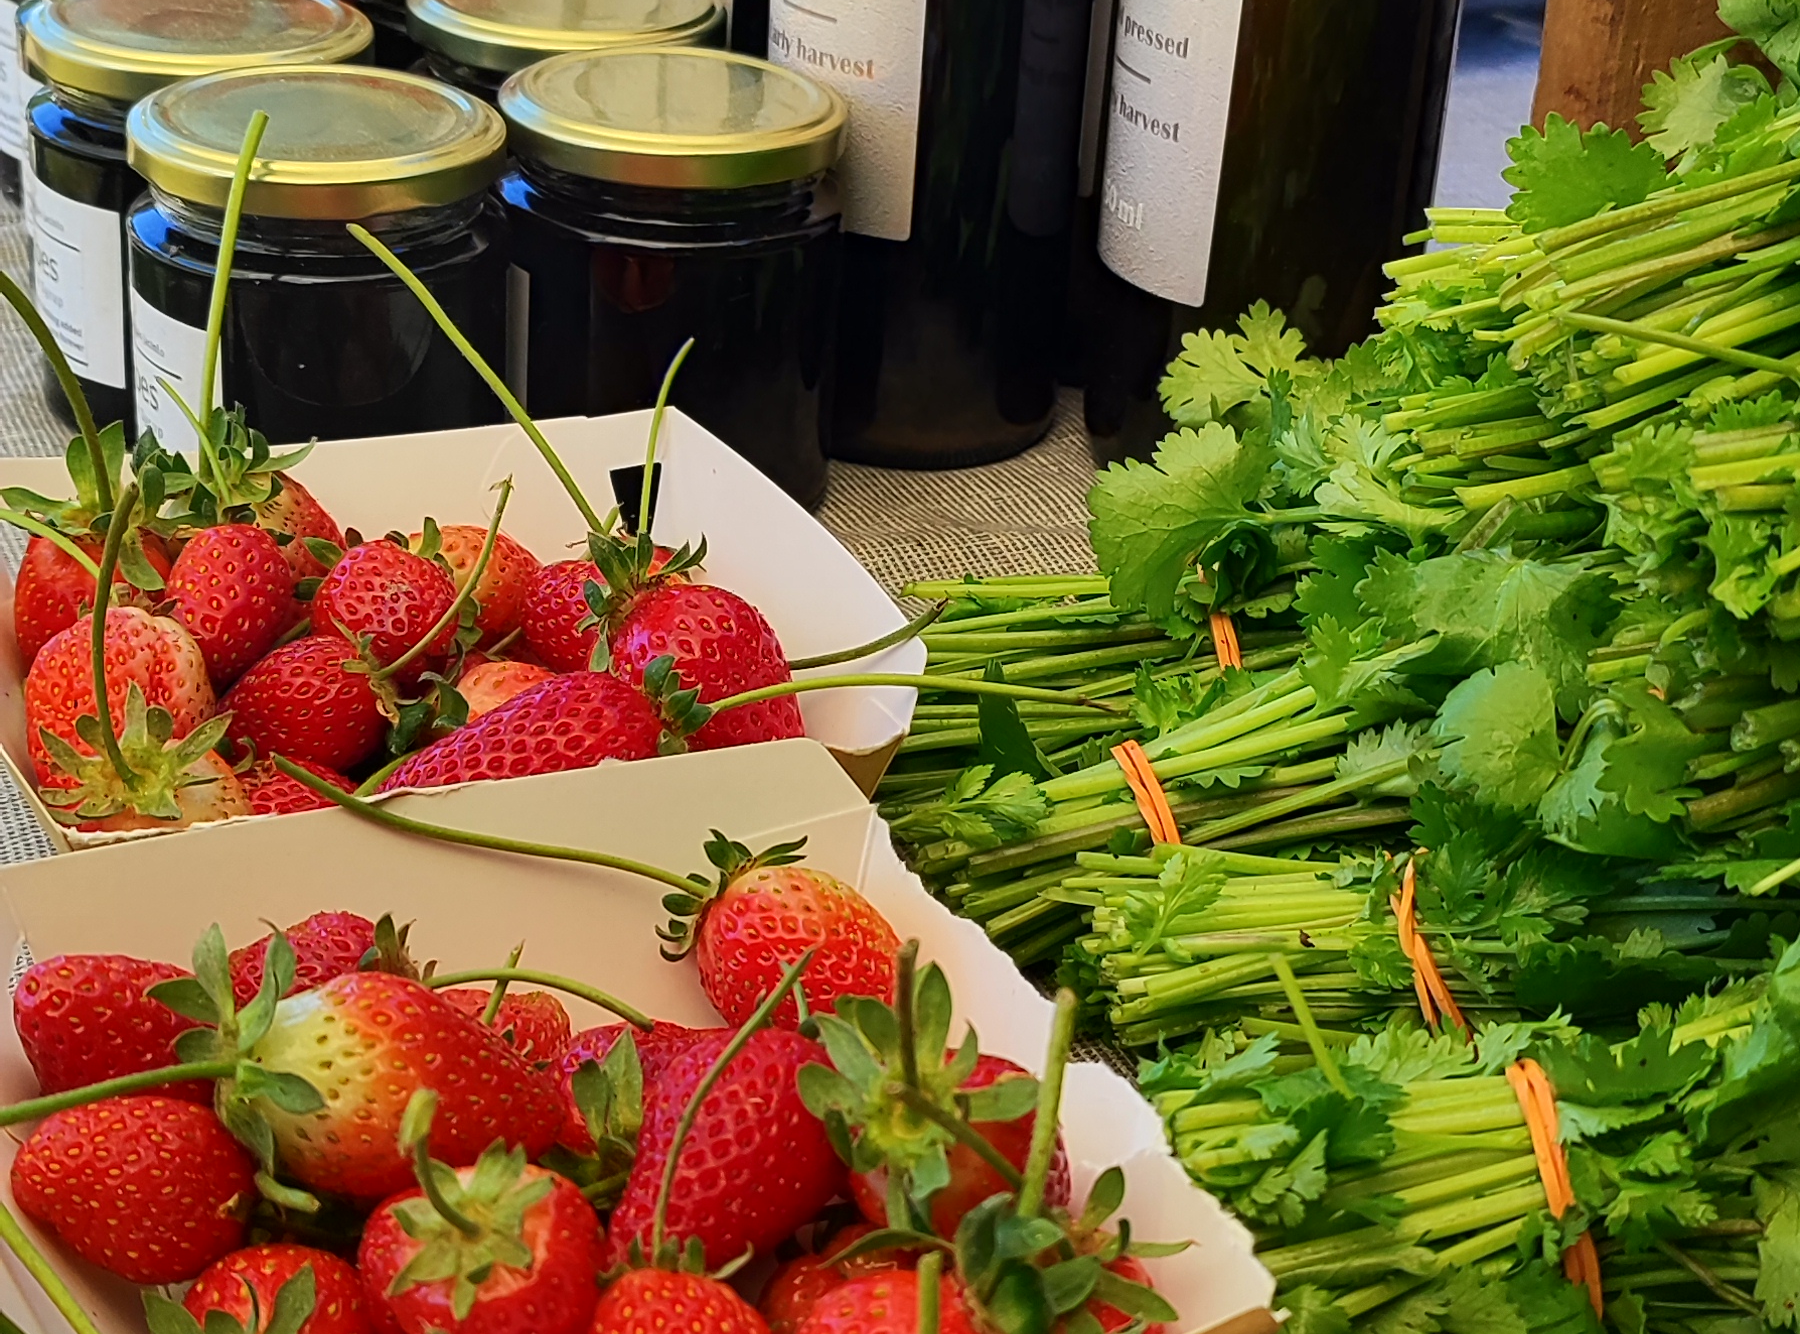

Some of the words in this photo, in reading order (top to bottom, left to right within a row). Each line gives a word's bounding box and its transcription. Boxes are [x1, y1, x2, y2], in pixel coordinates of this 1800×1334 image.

[795, 37, 876, 80] harvest
[1123, 14, 1190, 60] pressed
[1118, 93, 1181, 144] harvest
